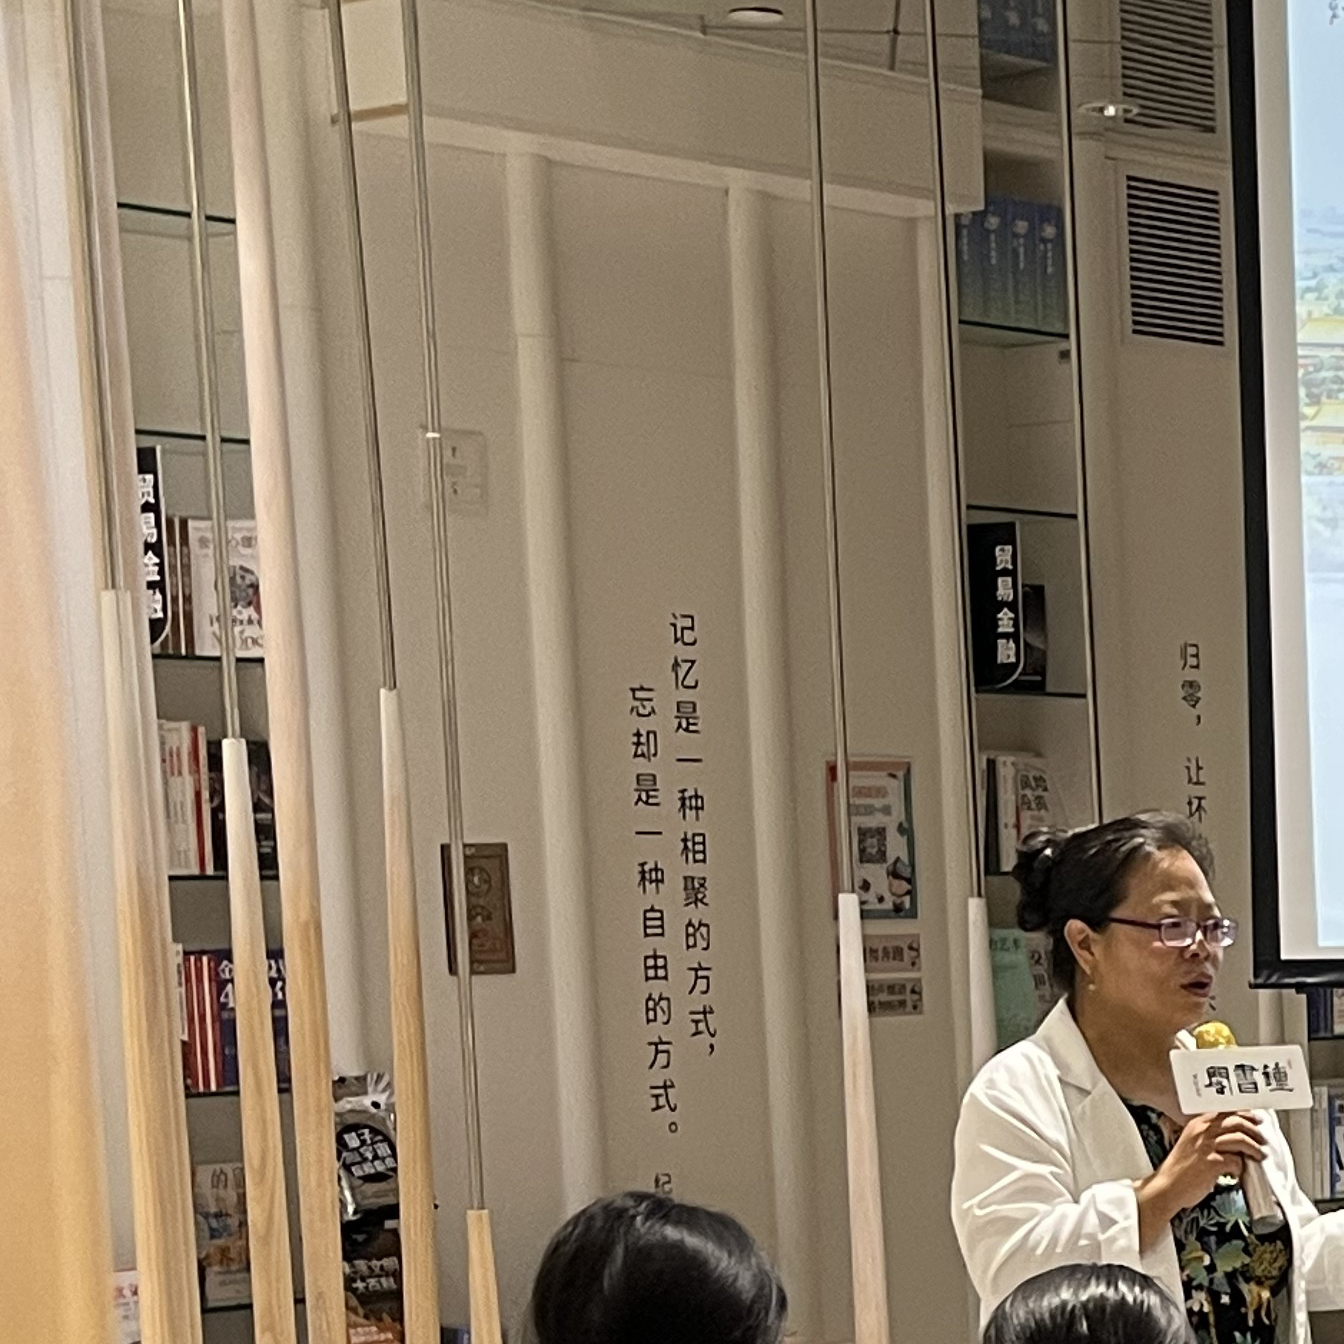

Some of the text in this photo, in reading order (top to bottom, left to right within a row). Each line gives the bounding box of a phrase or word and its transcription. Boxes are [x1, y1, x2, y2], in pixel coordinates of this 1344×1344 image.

[995, 544, 1017, 664] 贸易金融
[628, 683, 679, 1134] 忘却是一种自由的方式。
[669, 612, 718, 1057] 记忆是一种相聚的方式，
